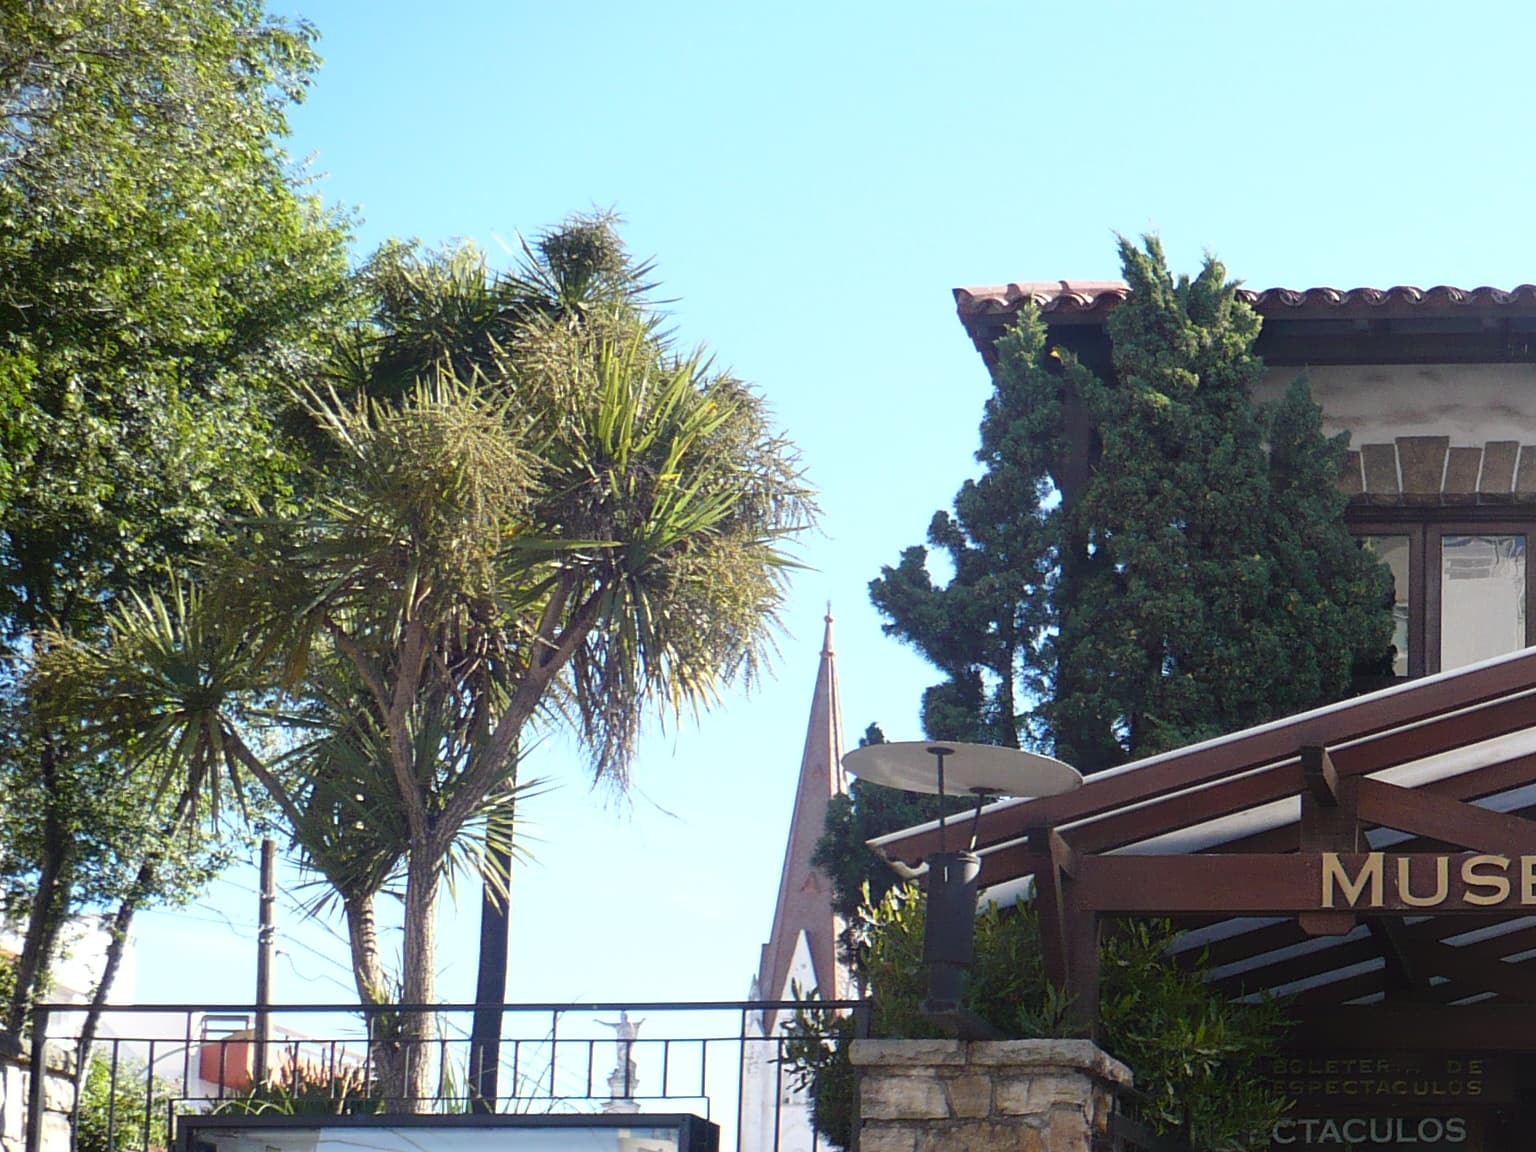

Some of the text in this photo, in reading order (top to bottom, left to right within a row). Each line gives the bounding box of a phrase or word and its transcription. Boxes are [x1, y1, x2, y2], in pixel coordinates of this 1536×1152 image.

[1273, 1059, 1484, 1074] BOLETERA DE
[1272, 1080, 1483, 1095] ESPECTACULOS
